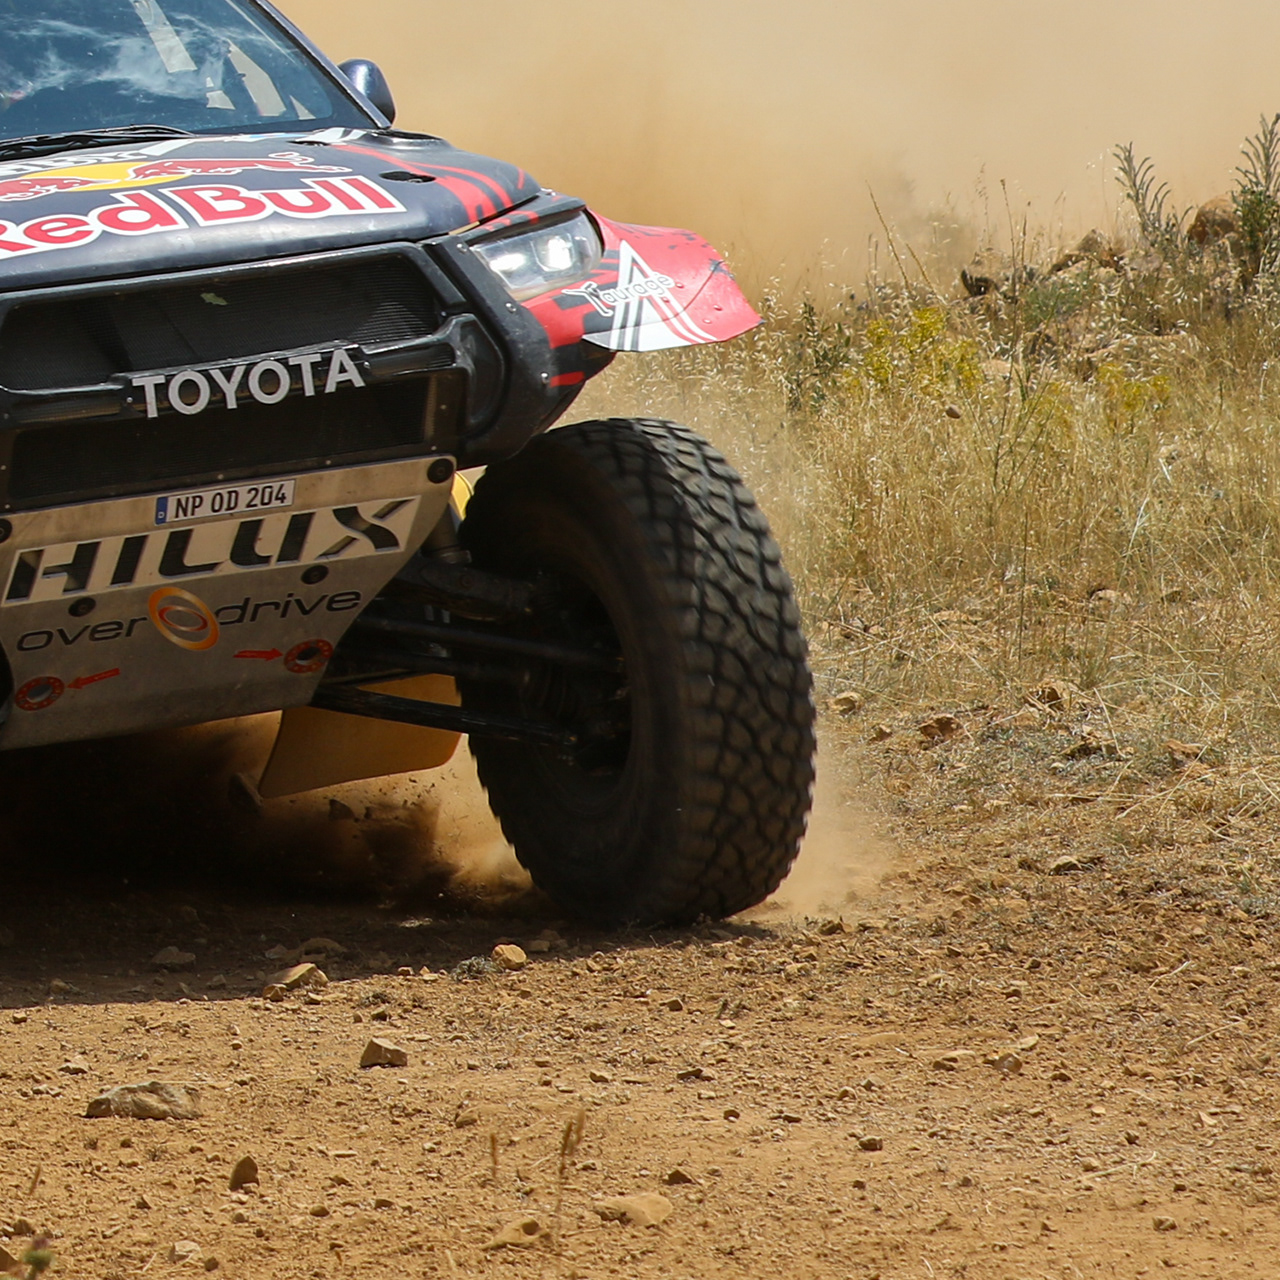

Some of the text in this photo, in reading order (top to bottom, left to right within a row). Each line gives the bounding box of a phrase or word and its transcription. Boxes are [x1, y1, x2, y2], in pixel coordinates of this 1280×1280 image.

[167, 178, 396, 224] Bull
[132, 349, 366, 418] TOYOTA
[175, 484, 287, 519] NP OD 204
[6, 498, 414, 602] HILUX
